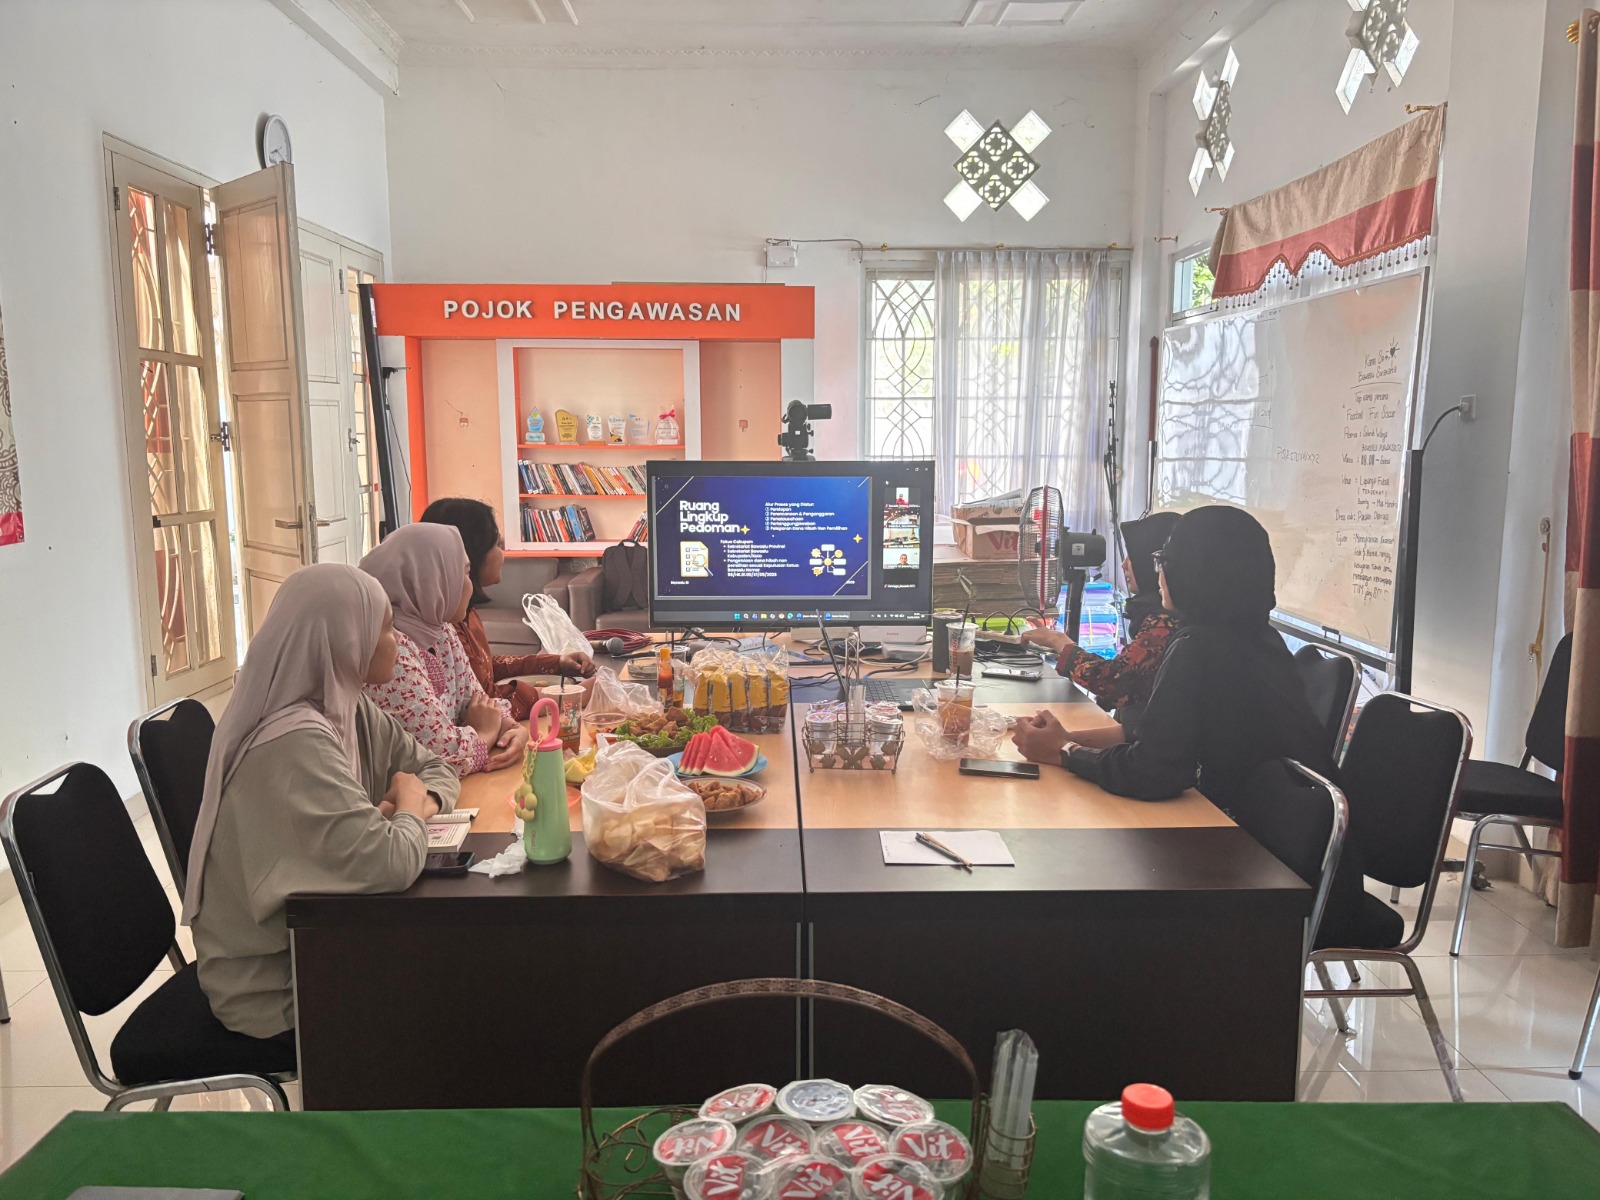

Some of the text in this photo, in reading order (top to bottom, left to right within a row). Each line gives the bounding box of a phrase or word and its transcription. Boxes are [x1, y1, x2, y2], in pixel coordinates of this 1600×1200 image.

[443, 299, 742, 322] POJOK PENGAWASAN
[680, 500, 719, 513] Ruang
[680, 511, 729, 524] Lingkup
[680, 523, 740, 533] Pedoman
[843, 1125, 882, 1157] Vit
[903, 1132, 955, 1160] Vit
[705, 1159, 743, 1196] Vit
[782, 1165, 833, 1198] Vit
